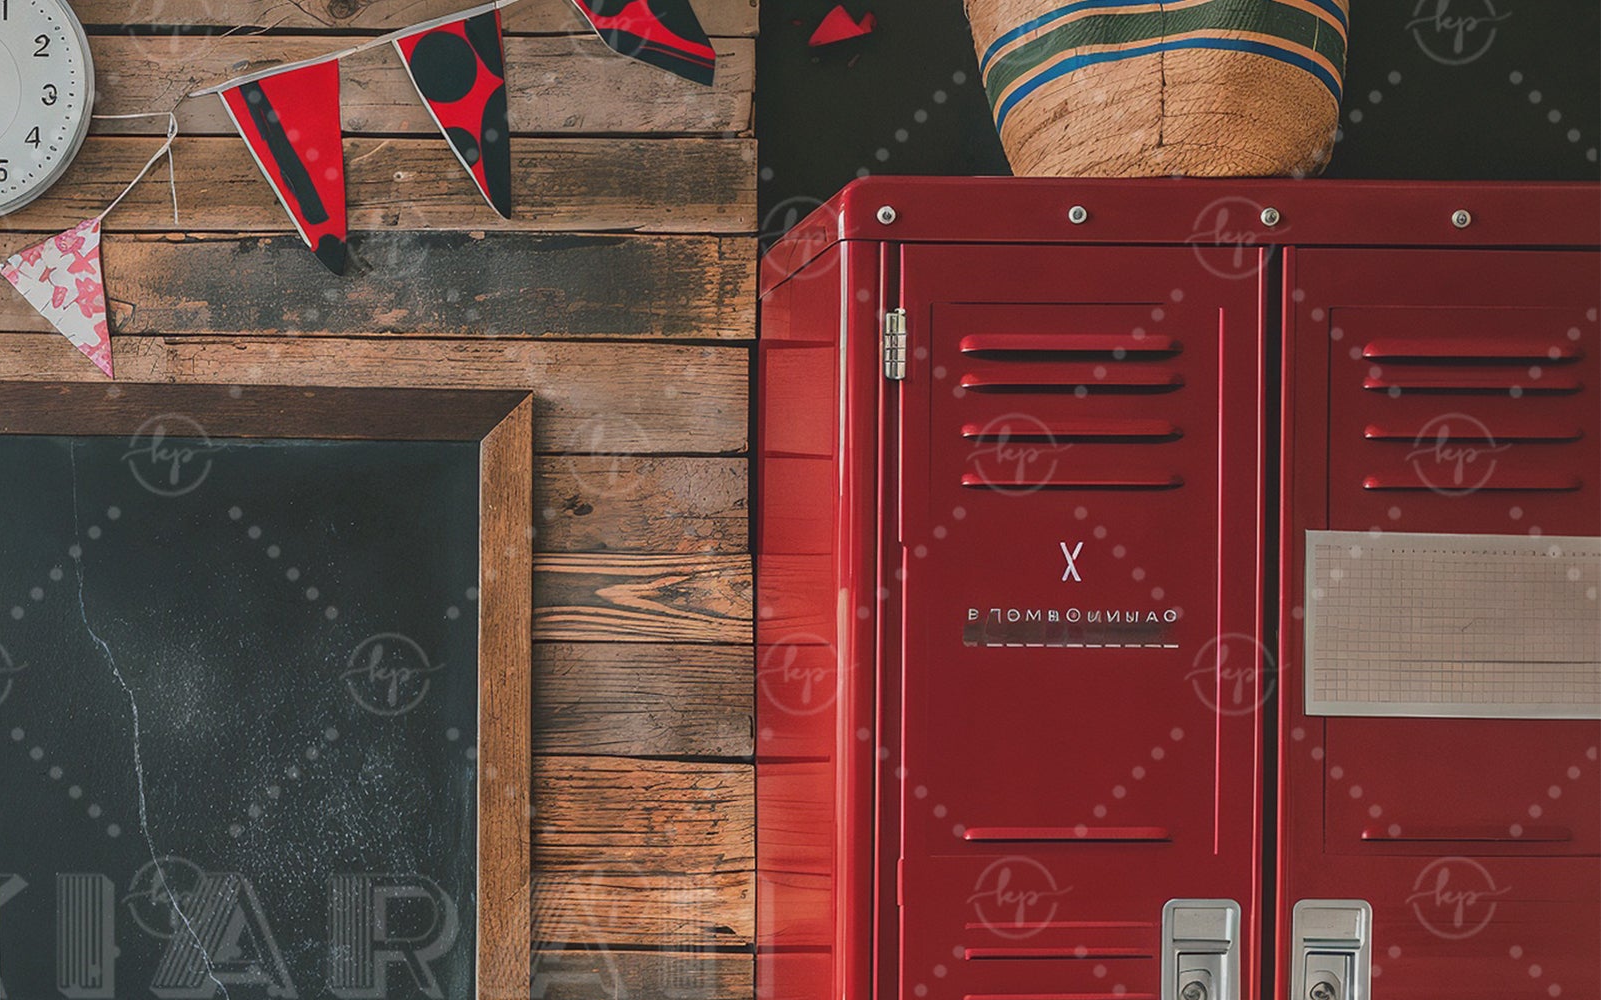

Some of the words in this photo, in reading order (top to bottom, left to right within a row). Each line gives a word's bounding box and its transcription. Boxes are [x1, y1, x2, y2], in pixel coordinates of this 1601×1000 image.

[33, 34, 51, 58] 2
[41, 84, 58, 107] 3
[24, 126, 41, 150] 4
[1059, 541, 1084, 582] X
